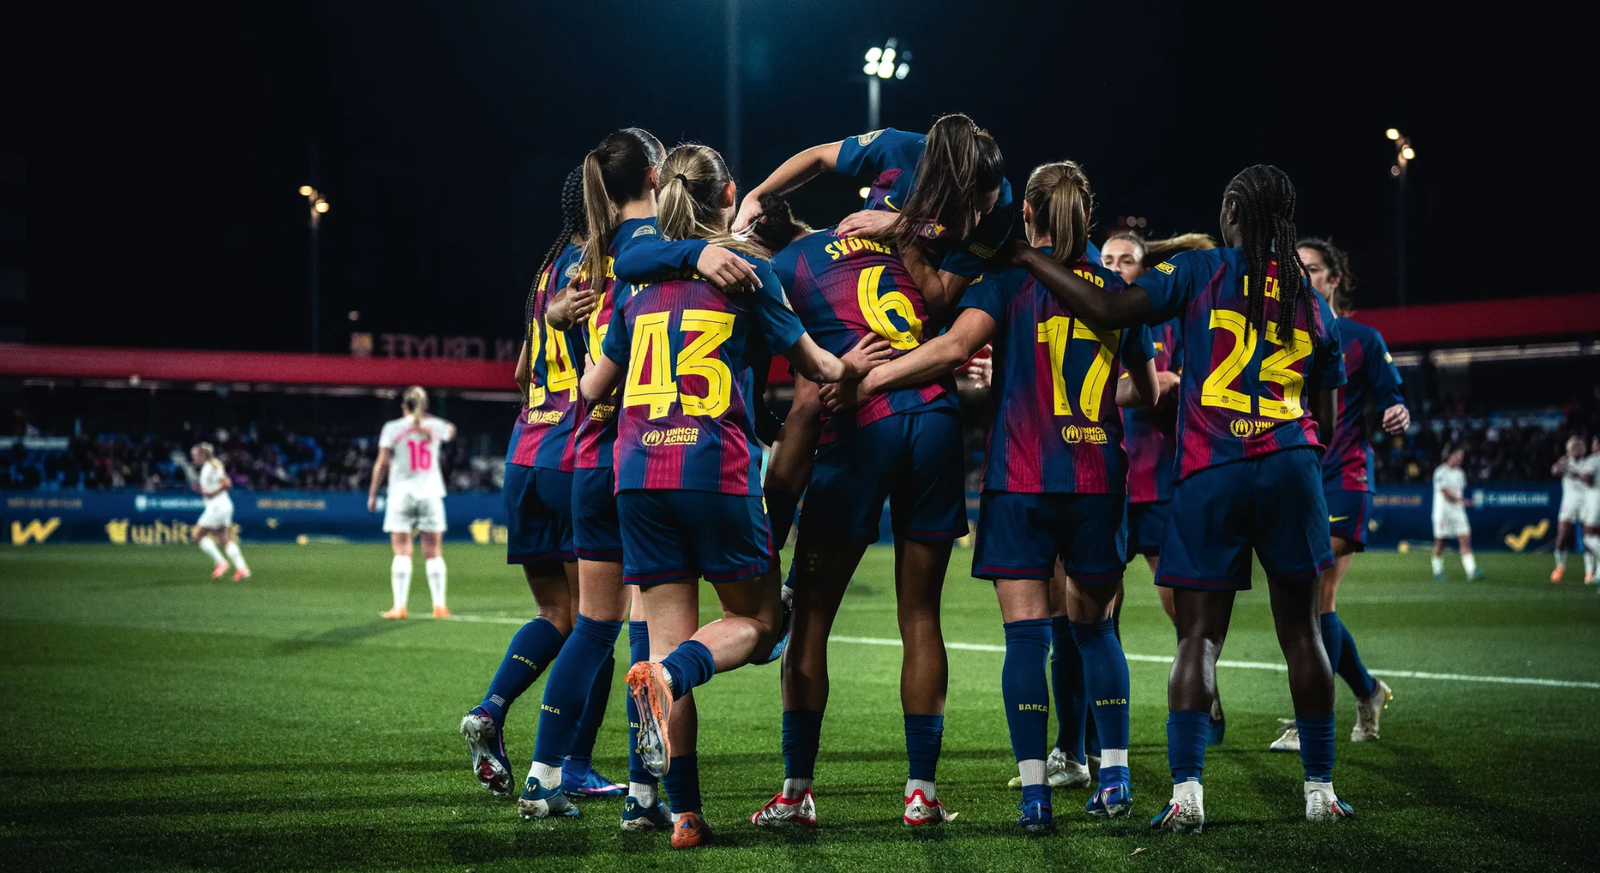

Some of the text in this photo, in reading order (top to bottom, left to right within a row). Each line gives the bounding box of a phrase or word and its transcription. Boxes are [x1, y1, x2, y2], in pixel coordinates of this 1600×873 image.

[858, 265, 923, 351] 6
[623, 309, 737, 420] 43
[1037, 315, 1121, 422] 17
[1201, 309, 1314, 420] 23
[406, 439, 433, 473] 16
[664, 434, 698, 443] ACNUR
[666, 427, 699, 436] UNHCR
